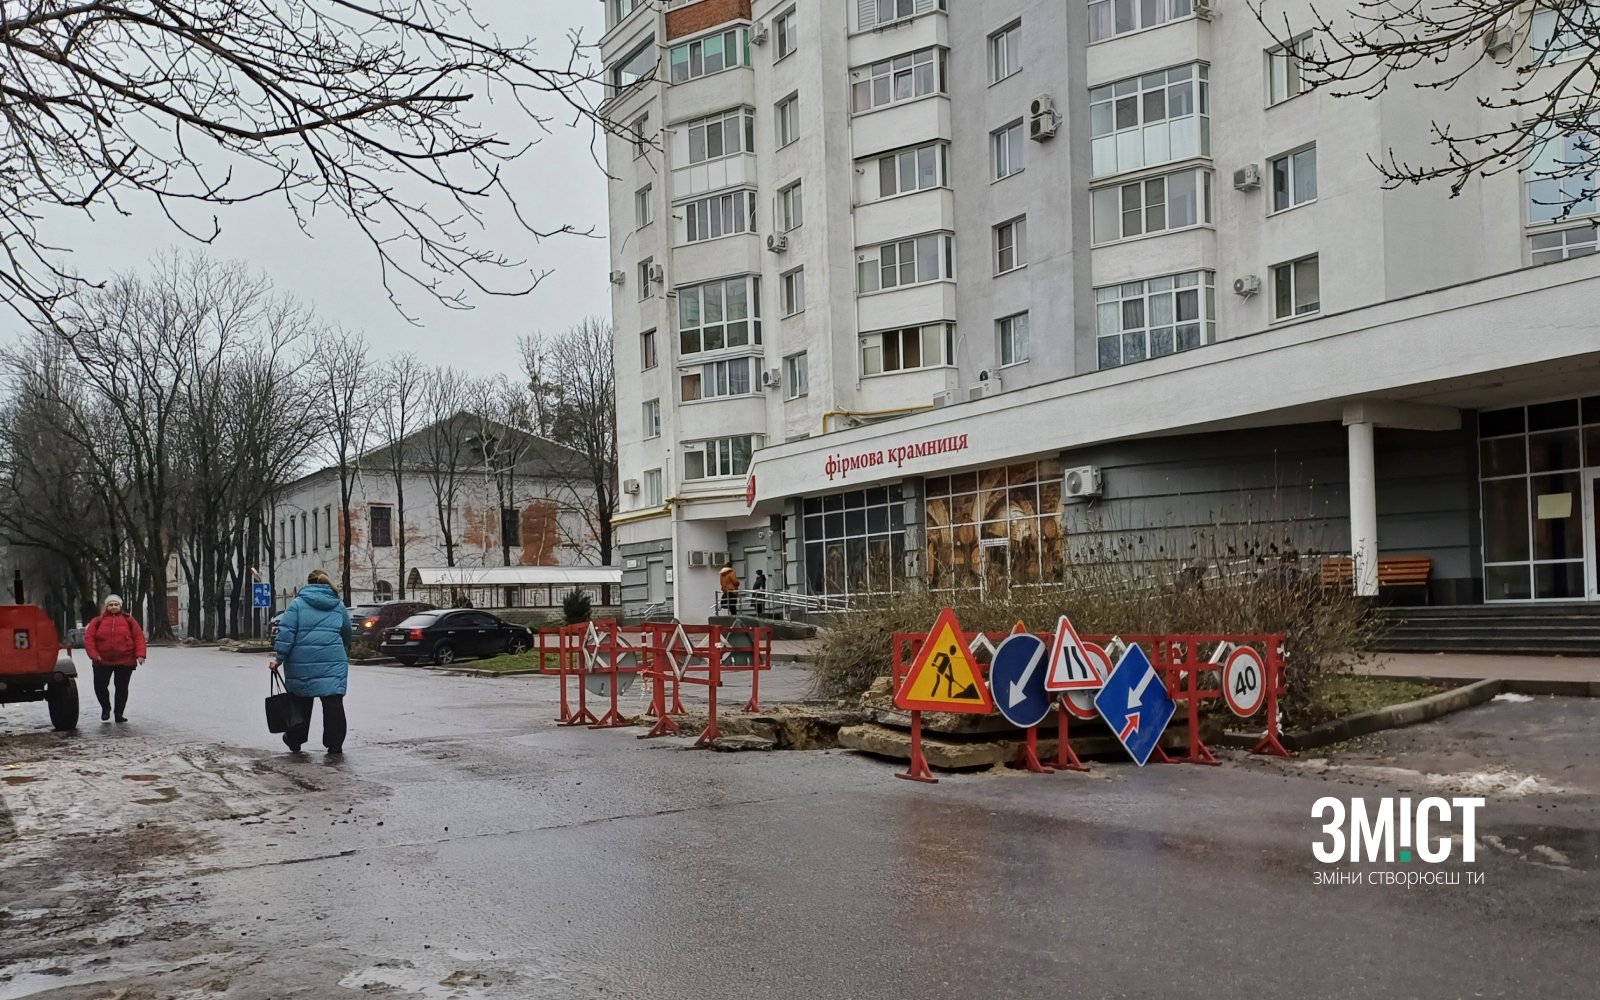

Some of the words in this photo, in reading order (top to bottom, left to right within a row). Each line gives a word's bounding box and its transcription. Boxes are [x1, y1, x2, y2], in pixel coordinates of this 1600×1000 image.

[825, 454, 884, 480] фірмова
[888, 433, 968, 468] крамниця
[14, 632, 29, 649] 6
[1235, 665, 1257, 696] 40
